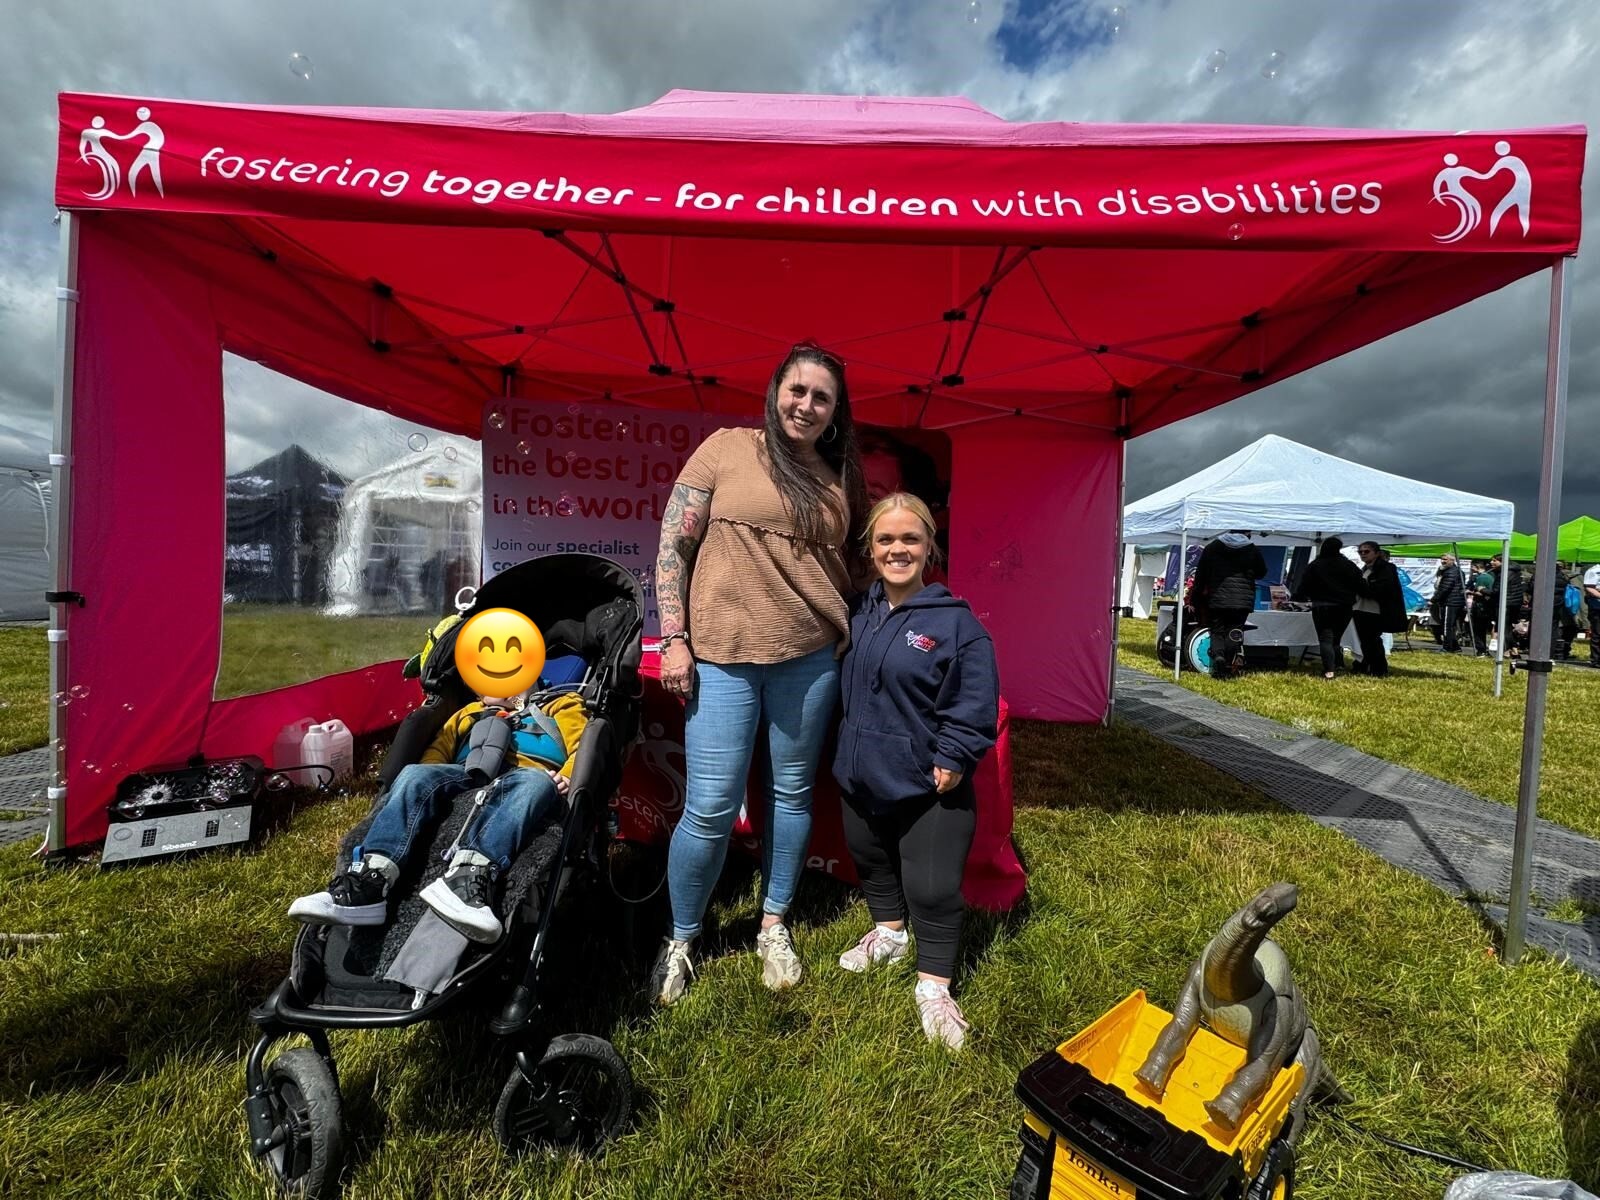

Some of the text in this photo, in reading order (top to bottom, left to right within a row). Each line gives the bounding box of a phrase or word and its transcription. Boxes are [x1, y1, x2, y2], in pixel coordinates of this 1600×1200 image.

[201, 147, 409, 196] fostering
[423, 170, 633, 204] together
[676, 183, 743, 210] for
[756, 187, 957, 215] children
[972, 191, 1082, 216] with
[1099, 180, 1381, 215] disabilities
[492, 454, 537, 476] the
[546, 447, 630, 482] best
[493, 493, 665, 521] in the worl
[492, 539, 640, 556] Join our specialist
[1065, 1146, 1120, 1195] Tonka
